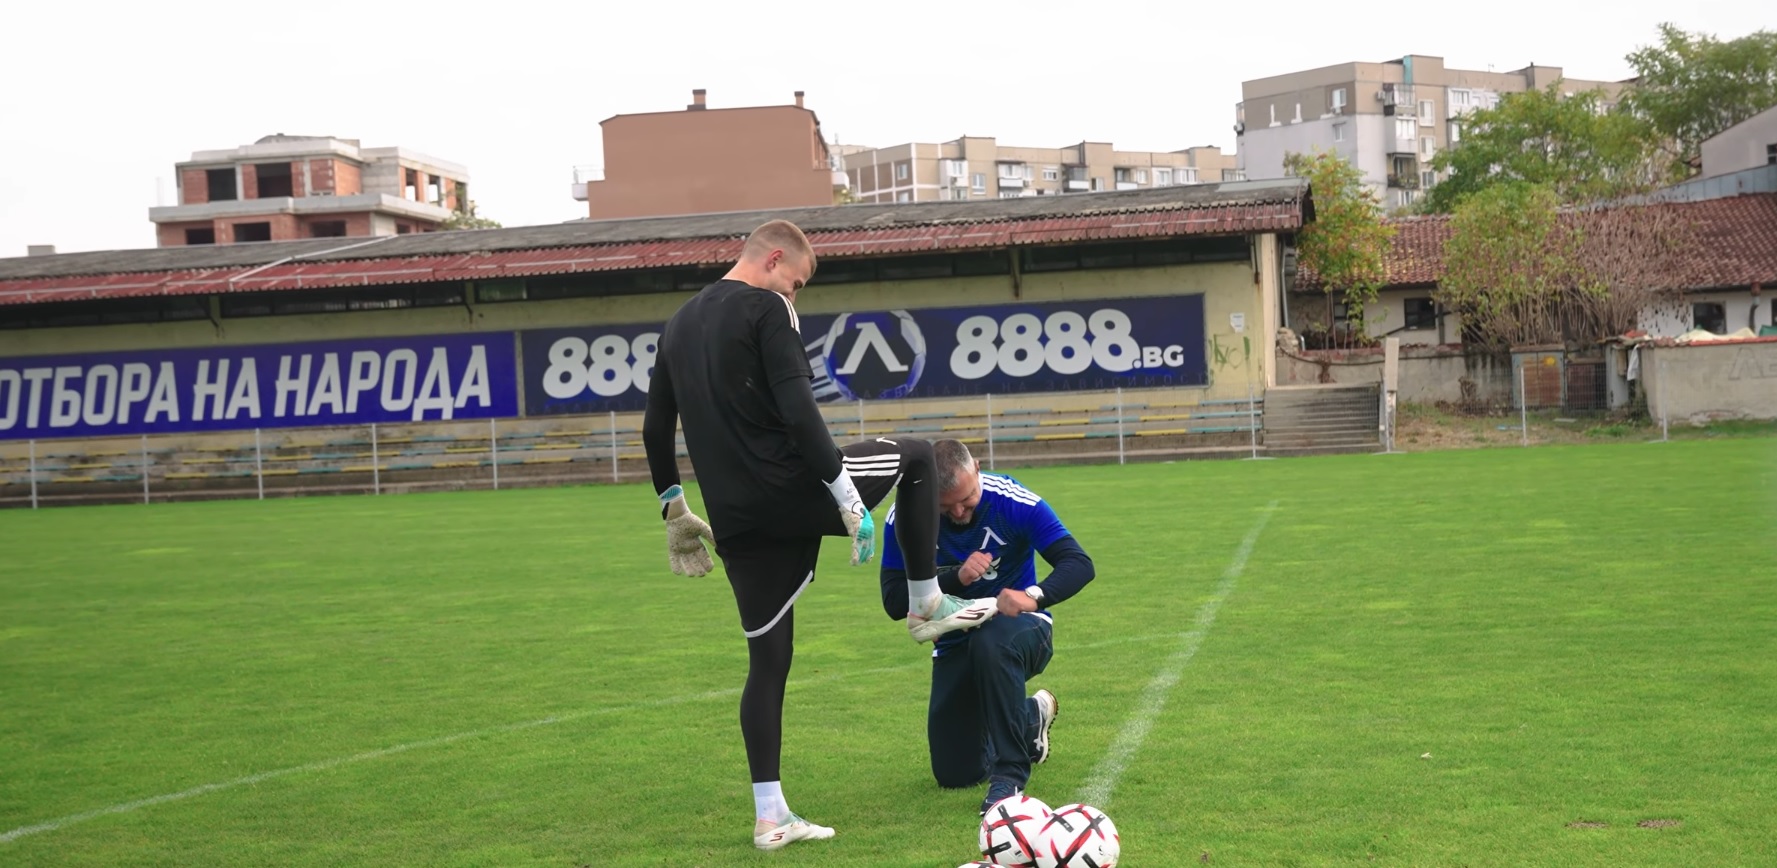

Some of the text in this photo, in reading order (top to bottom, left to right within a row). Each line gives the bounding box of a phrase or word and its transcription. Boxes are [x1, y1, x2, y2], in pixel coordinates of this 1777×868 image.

[192, 357, 261, 421] НА
[274, 345, 491, 421] НАРОДА
[543, 332, 661, 399] 888
